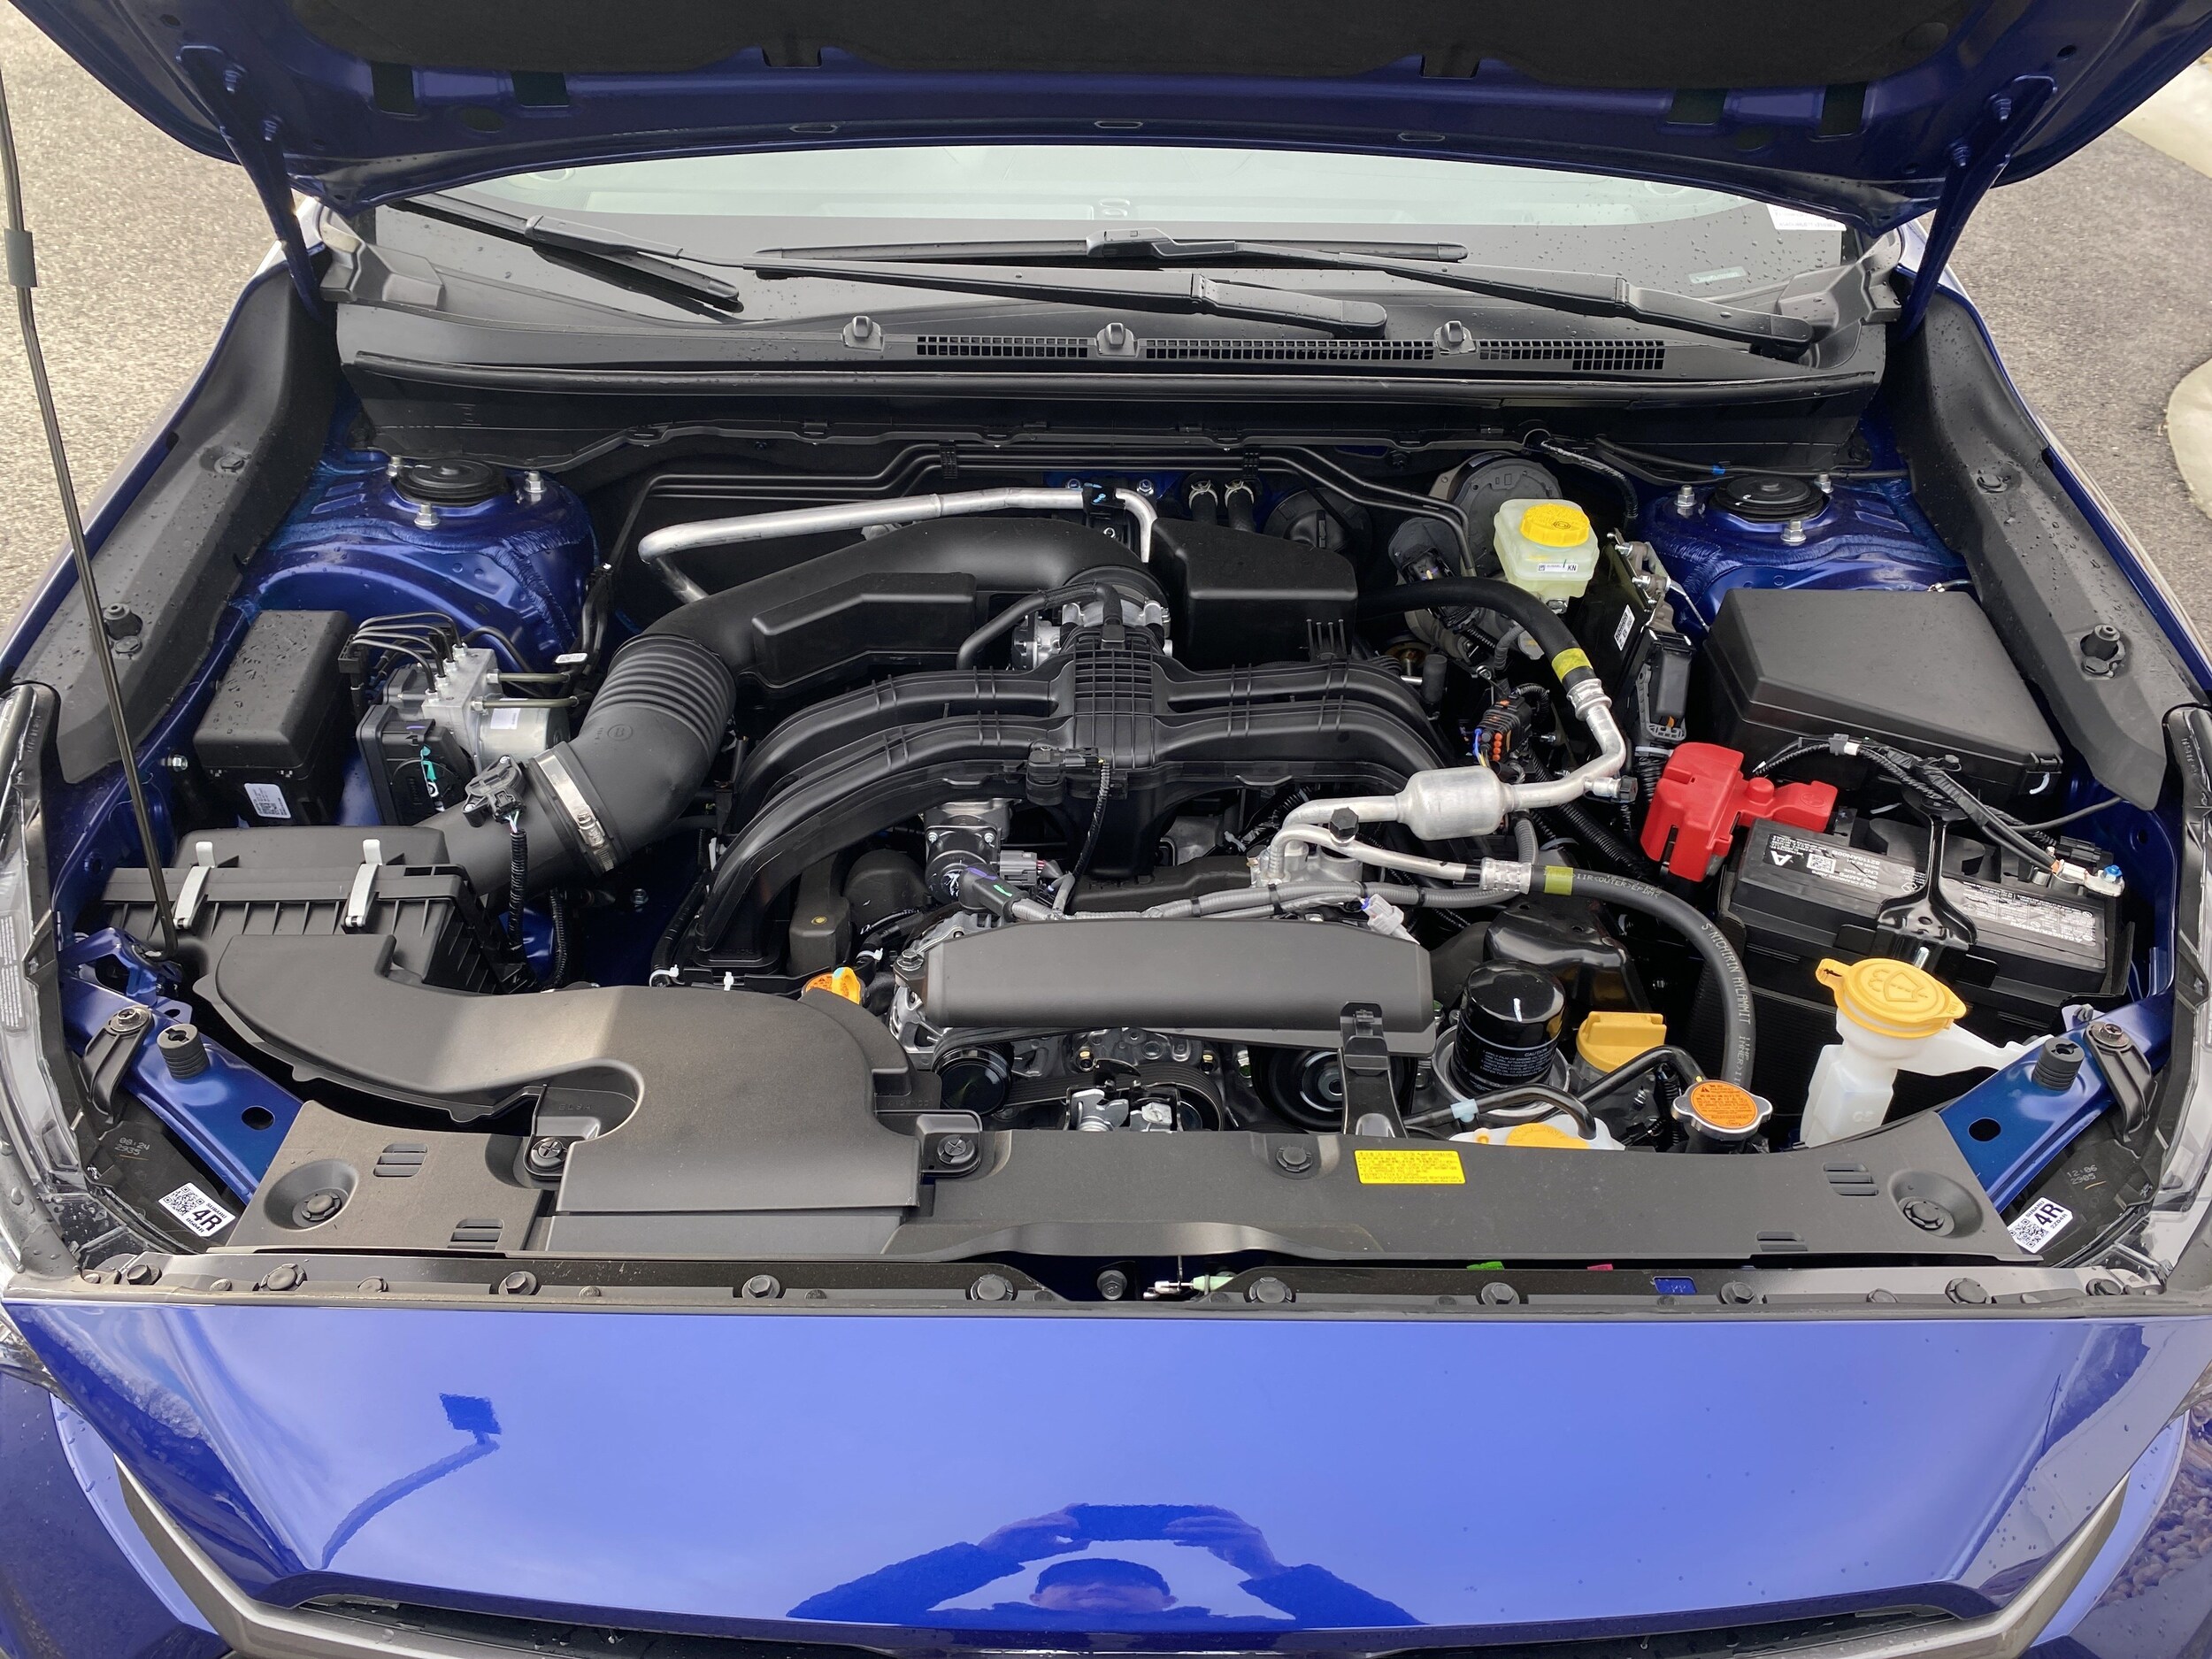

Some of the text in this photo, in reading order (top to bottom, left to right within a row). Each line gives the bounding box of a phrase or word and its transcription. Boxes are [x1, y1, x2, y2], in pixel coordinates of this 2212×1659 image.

[1770, 850, 1793, 866] A
[1839, 872, 1861, 882] AMPS
[1525, 1048, 1548, 1057] CAUTION
[205, 1202, 228, 1219] SUBARU
[2034, 1202, 2064, 1225] 4R
[192, 1209, 223, 1232] 4R
